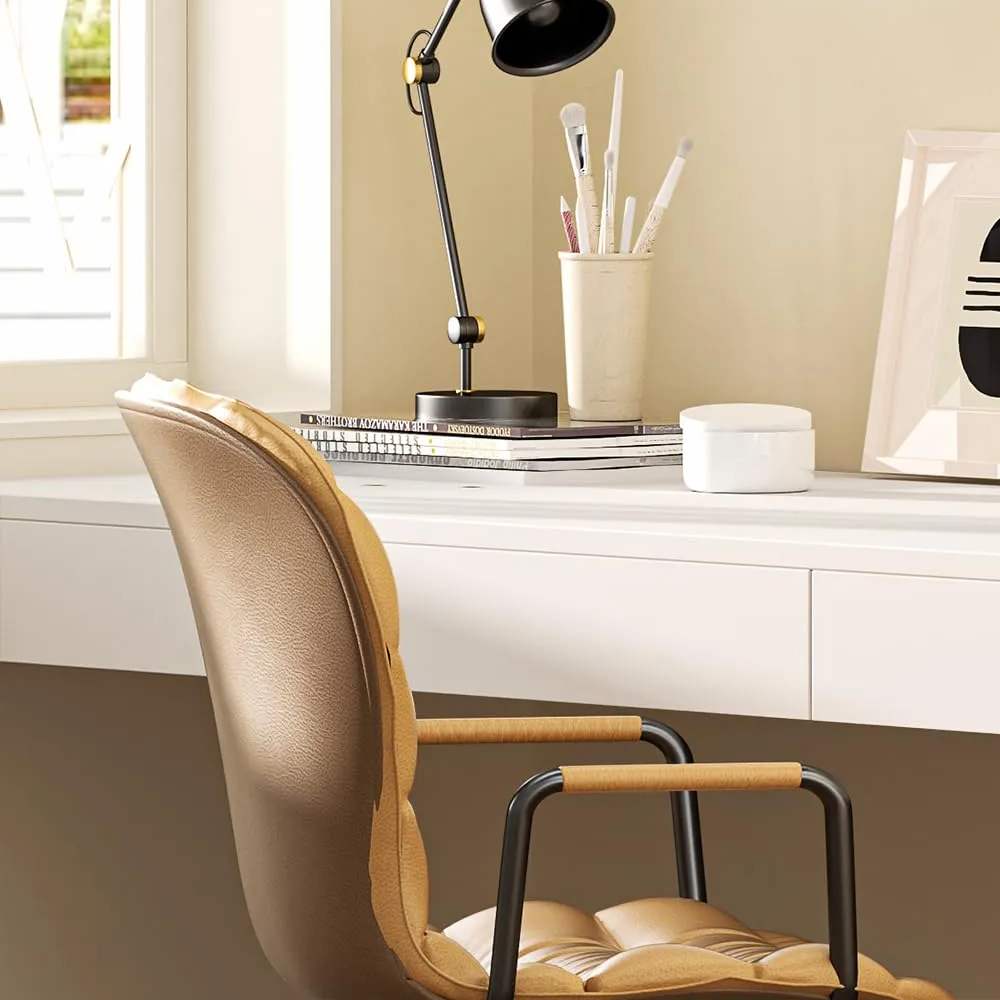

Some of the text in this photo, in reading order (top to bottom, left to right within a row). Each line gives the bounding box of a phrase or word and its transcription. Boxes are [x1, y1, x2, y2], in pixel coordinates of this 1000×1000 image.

[316, 415, 511, 437] FYODOR DOSTOEVSKY THE KARAMAZOV BROTHERS
